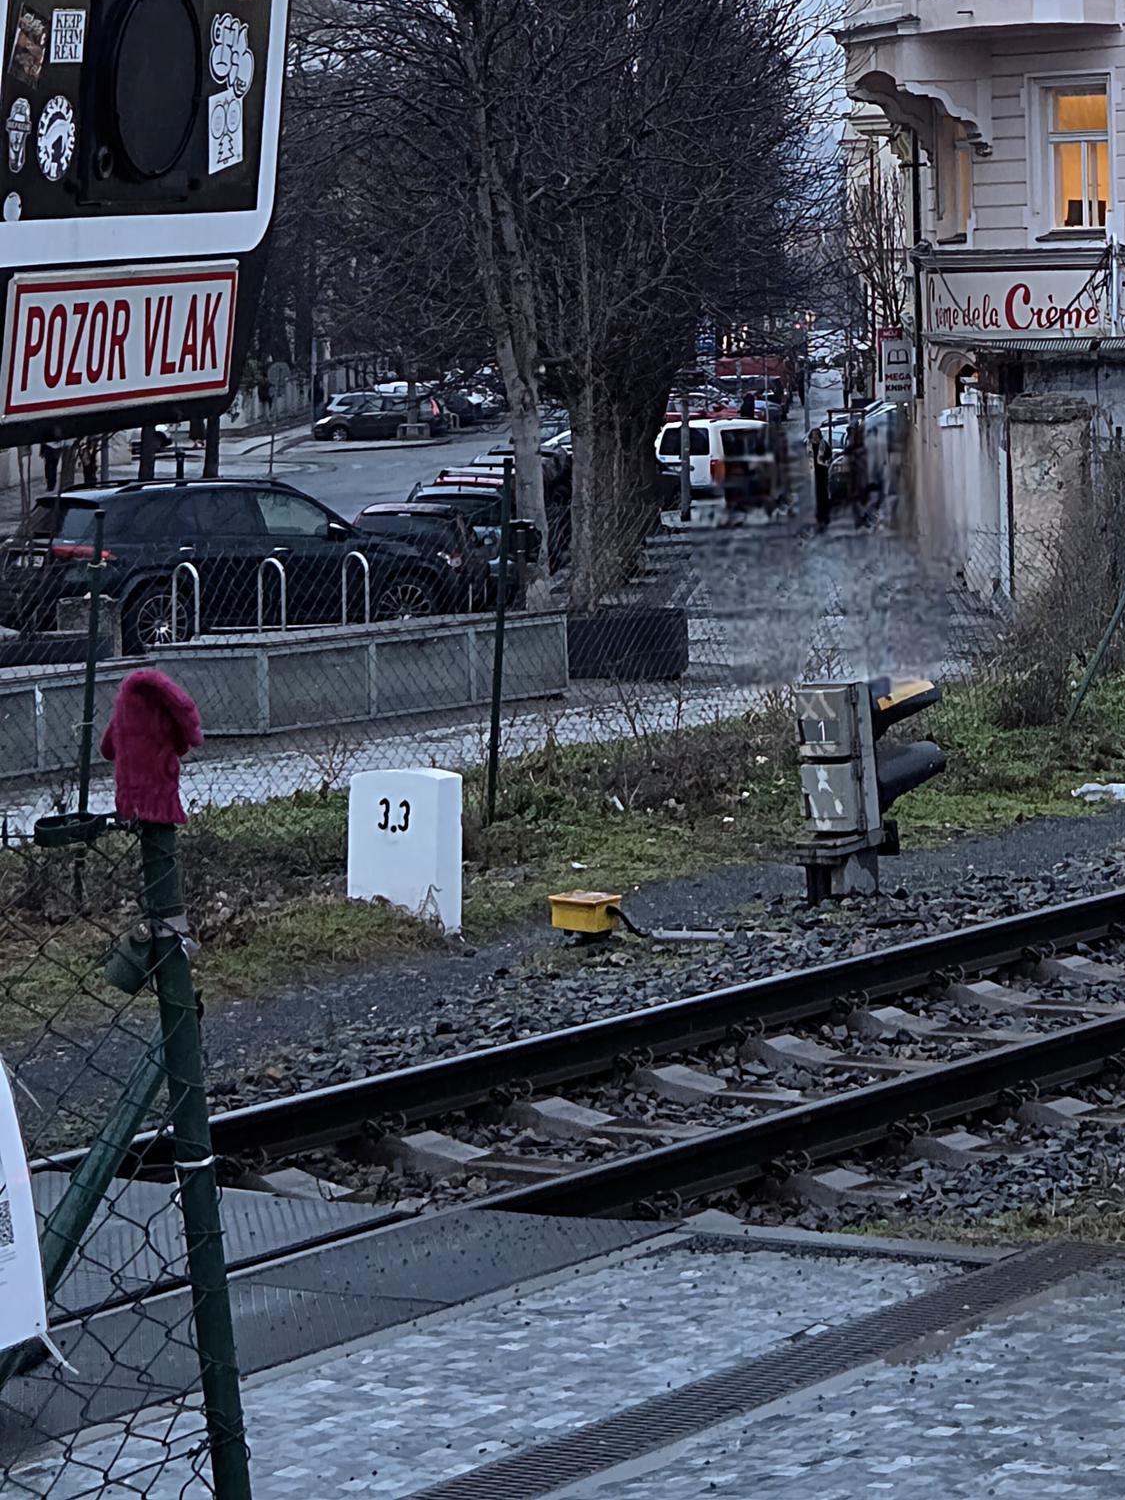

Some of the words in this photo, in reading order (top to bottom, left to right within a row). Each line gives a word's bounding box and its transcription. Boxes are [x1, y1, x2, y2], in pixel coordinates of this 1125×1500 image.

[53, 44, 80, 61] REAL
[961, 294, 981, 328] de
[981, 293, 1001, 329] la
[1004, 282, 1099, 331] Crème
[20, 298, 131, 392] POZOR
[144, 291, 224, 377] VLAK
[885, 372, 912, 381] MEGA
[377, 797, 411, 833] 3.3
